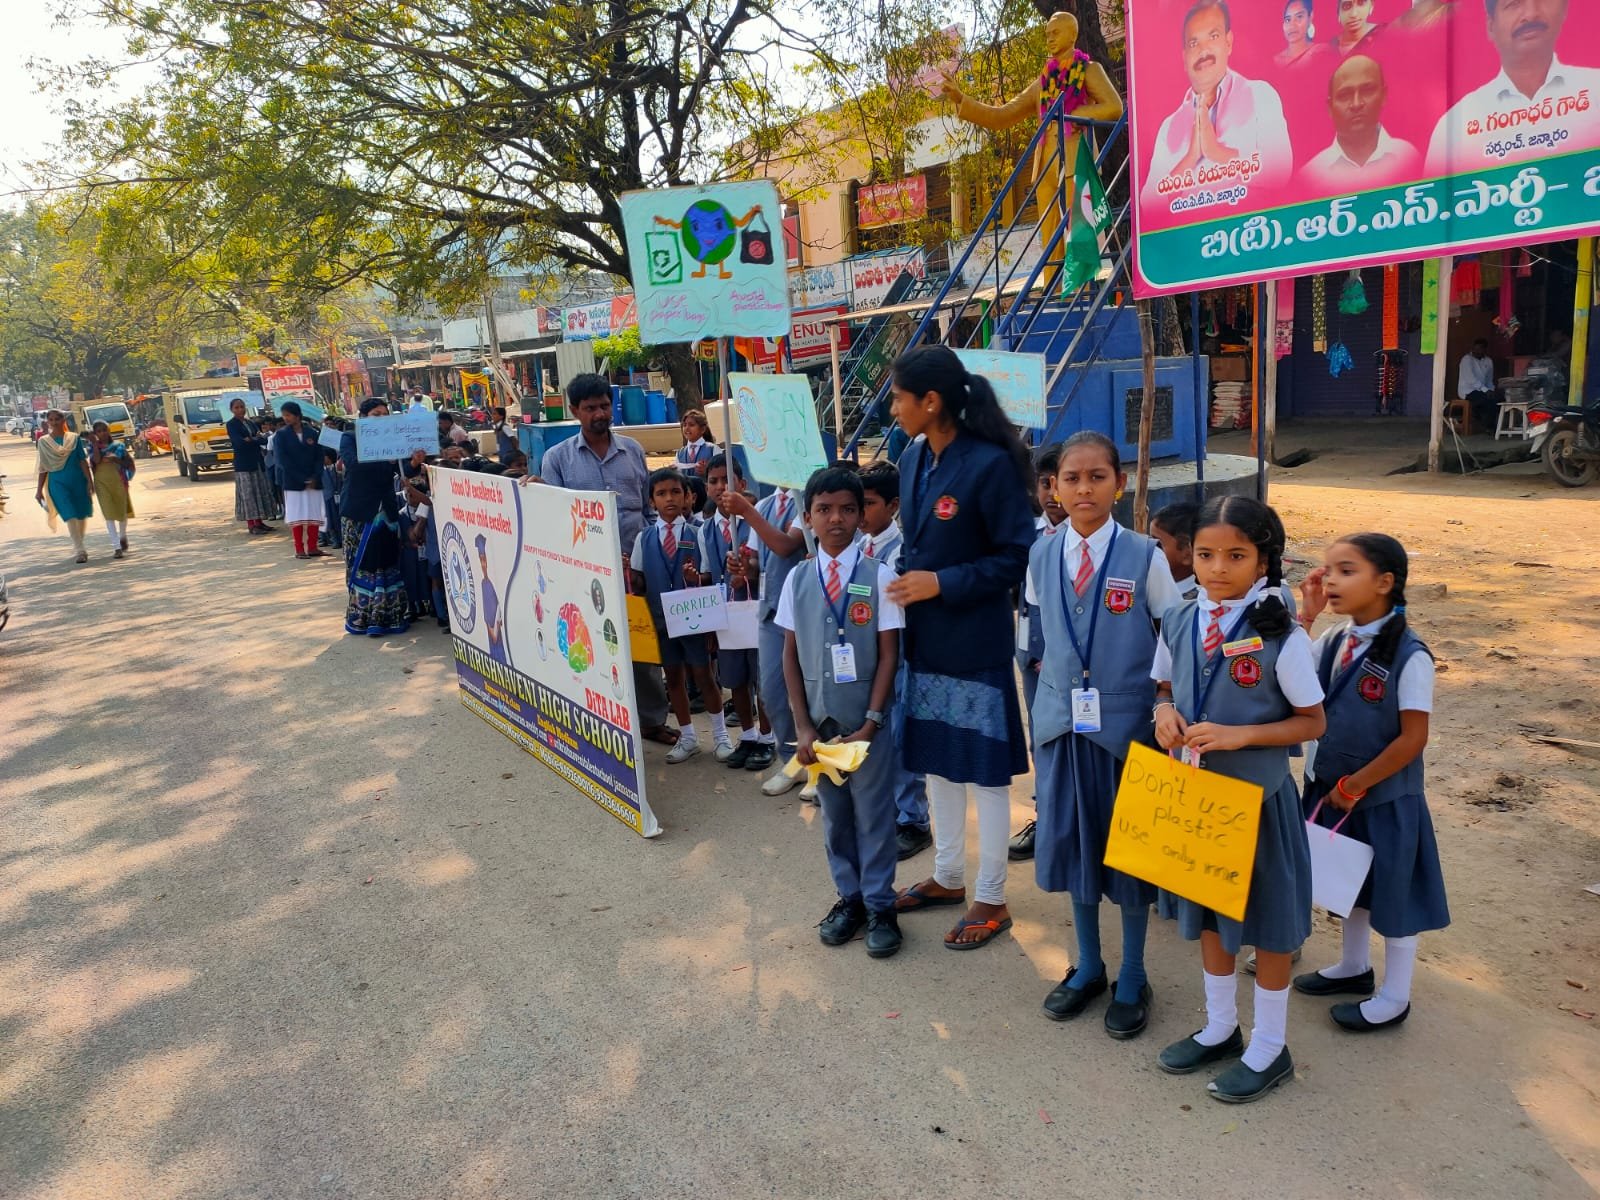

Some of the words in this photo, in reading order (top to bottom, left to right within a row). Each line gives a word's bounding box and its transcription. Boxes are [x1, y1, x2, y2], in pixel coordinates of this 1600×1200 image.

[670, 594, 719, 616] CARRIER
[452, 636, 469, 665] SRI
[468, 644, 538, 709] KRISHNAVENI
[539, 686, 572, 730] HIGH
[573, 706, 635, 769] SCHOOL
[609, 700, 631, 731] LAB
[1127, 758, 1187, 806] Don't
[1119, 817, 1151, 846] use
[1153, 806, 1229, 848] plastic
